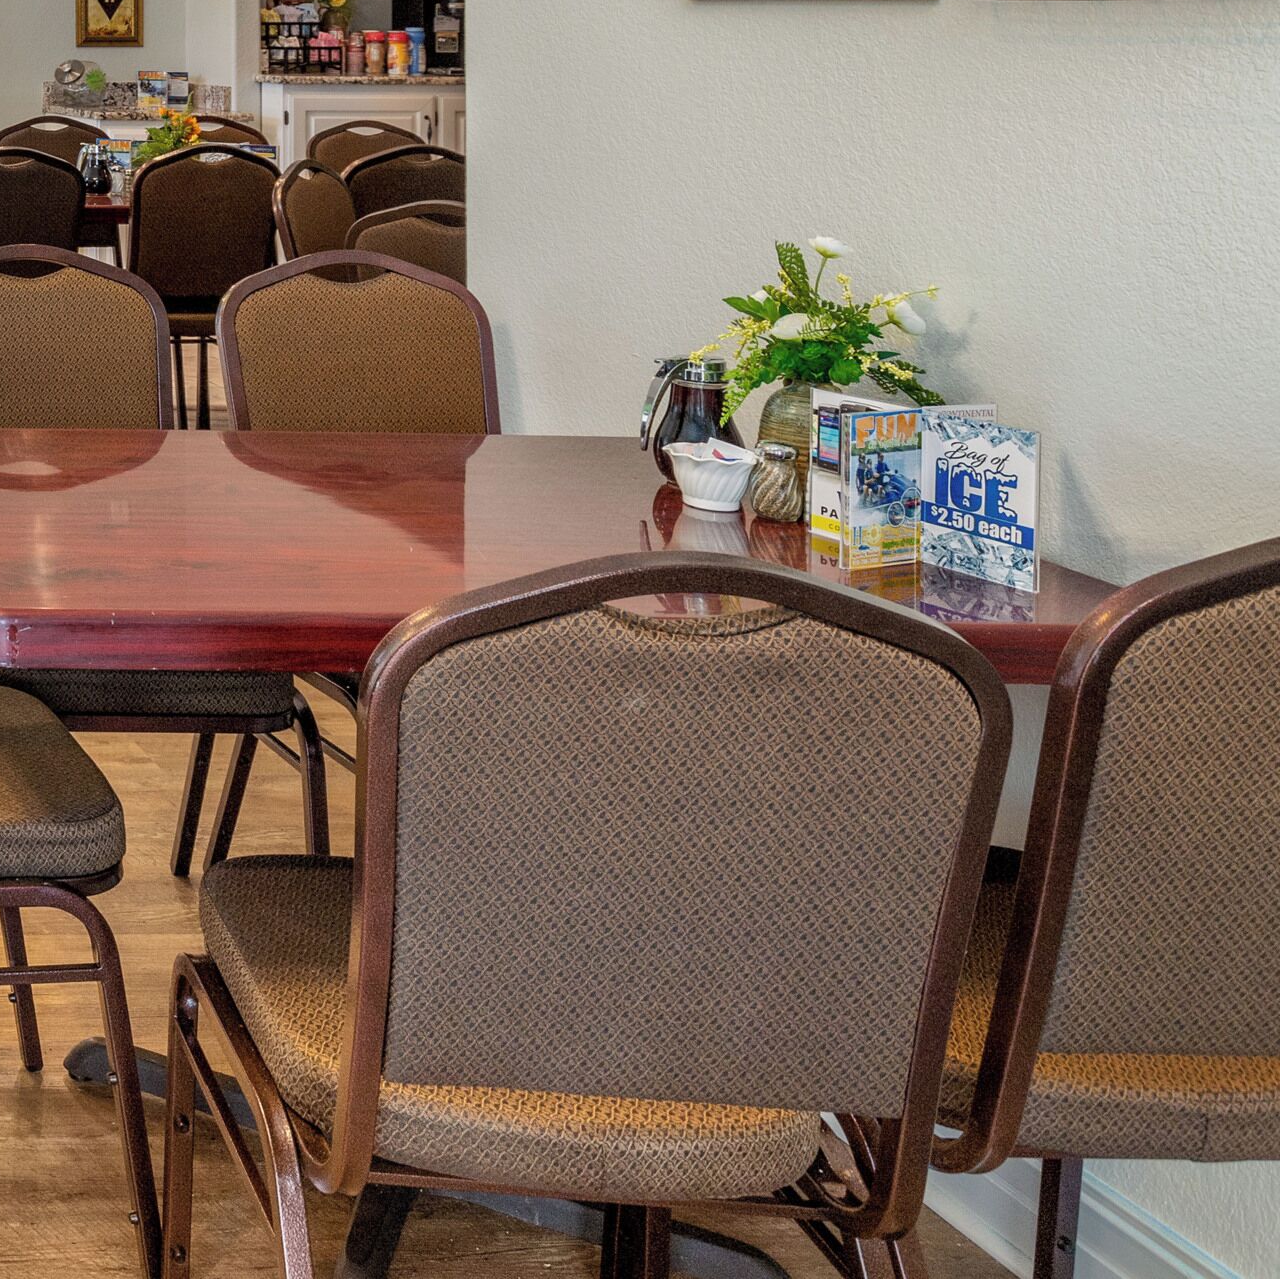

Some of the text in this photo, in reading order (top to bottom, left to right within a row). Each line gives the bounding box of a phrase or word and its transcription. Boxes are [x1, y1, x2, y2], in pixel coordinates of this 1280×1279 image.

[856, 413, 917, 448] FUN
[944, 441, 988, 467] Bag
[991, 454, 1010, 472] of
[935, 457, 1018, 524] ICE
[820, 506, 839, 520] PA
[930, 505, 1023, 545] $2.50 each
